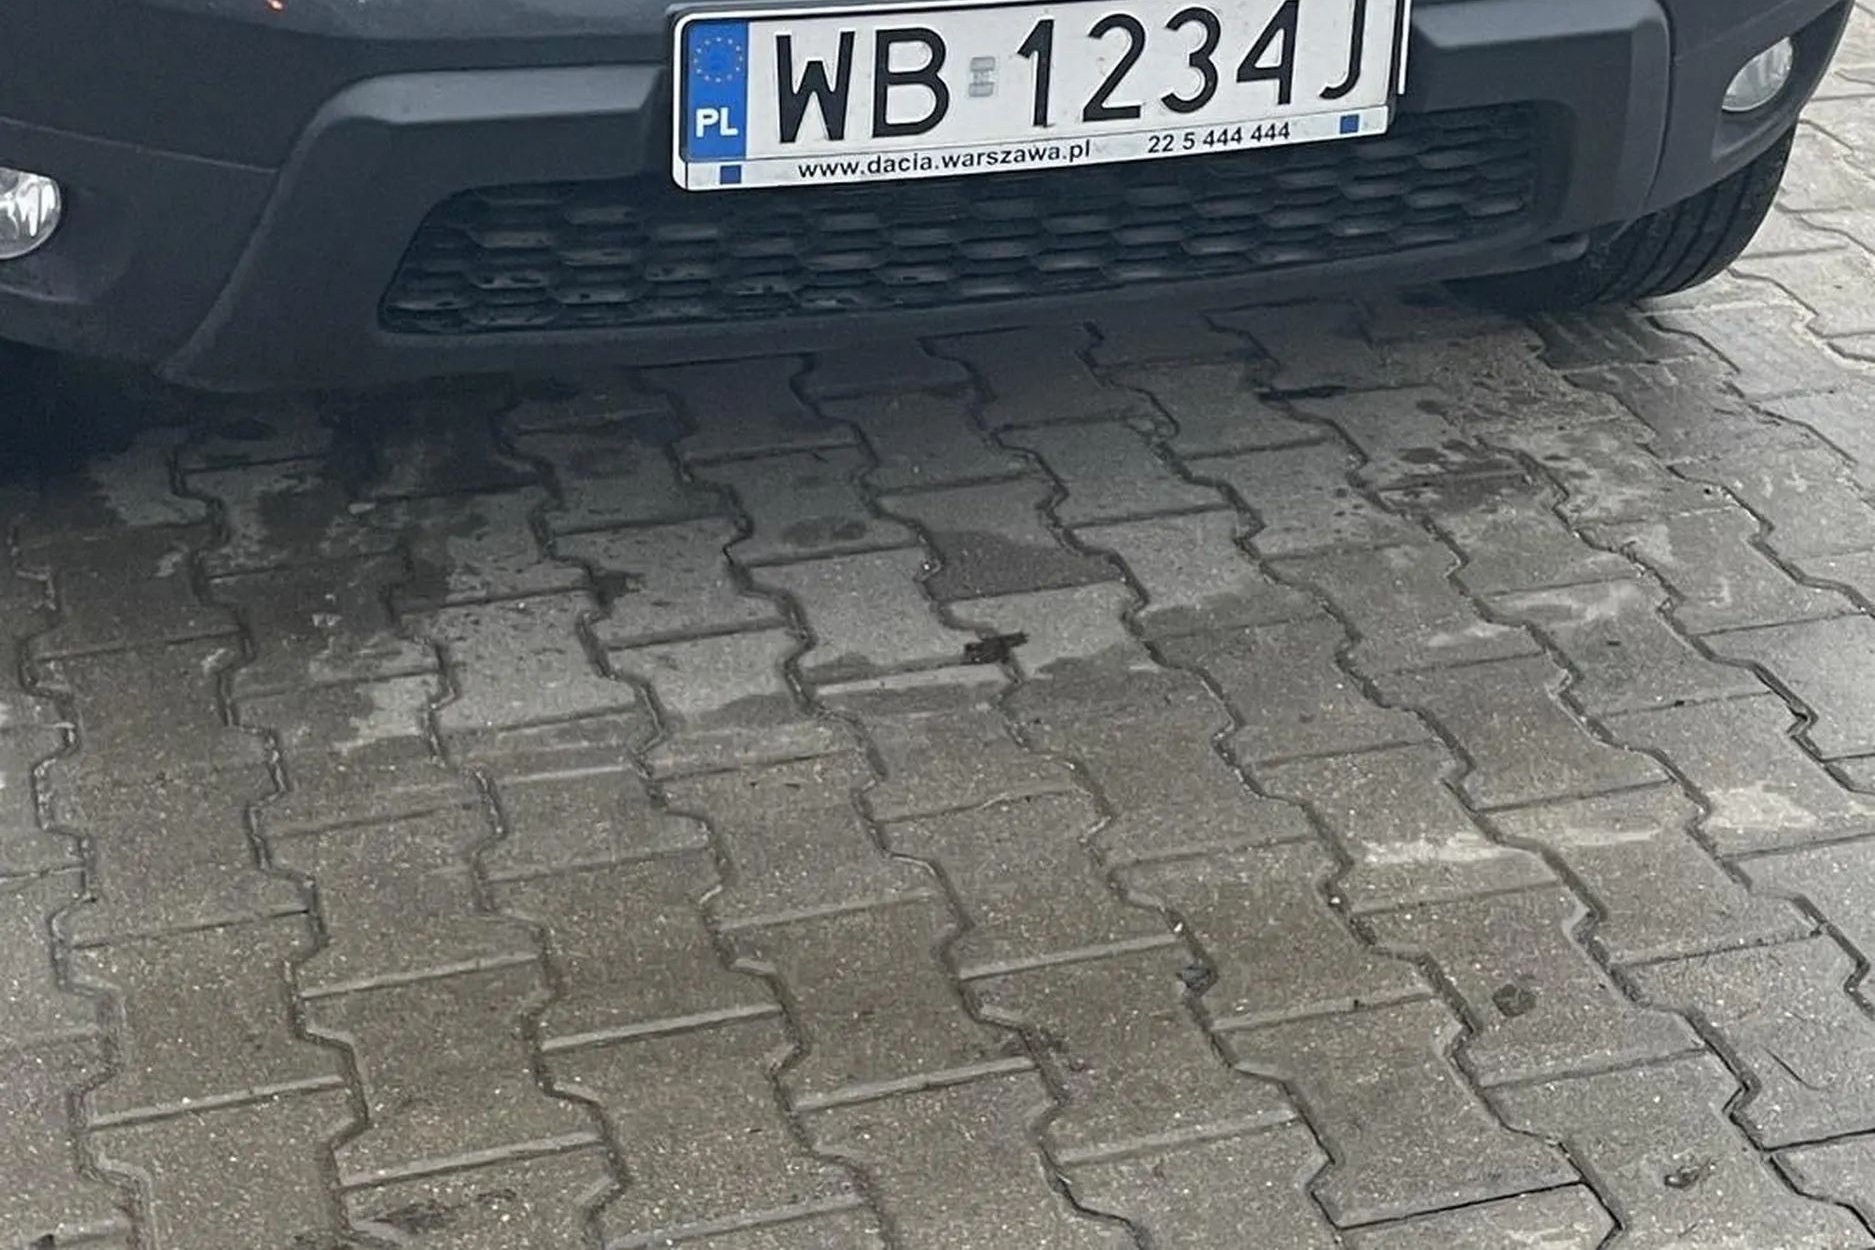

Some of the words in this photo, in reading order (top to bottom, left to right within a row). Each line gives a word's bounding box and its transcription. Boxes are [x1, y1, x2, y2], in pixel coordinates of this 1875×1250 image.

[775, 28, 951, 144] WB
[696, 107, 739, 138] PL
[798, 138, 1091, 178] www.dacia.warszawa.pl
[1148, 135, 1175, 153] 22
[1182, 132, 1196, 150] 5
[1202, 126, 1243, 149] 444
[1249, 121, 1291, 140] 444
